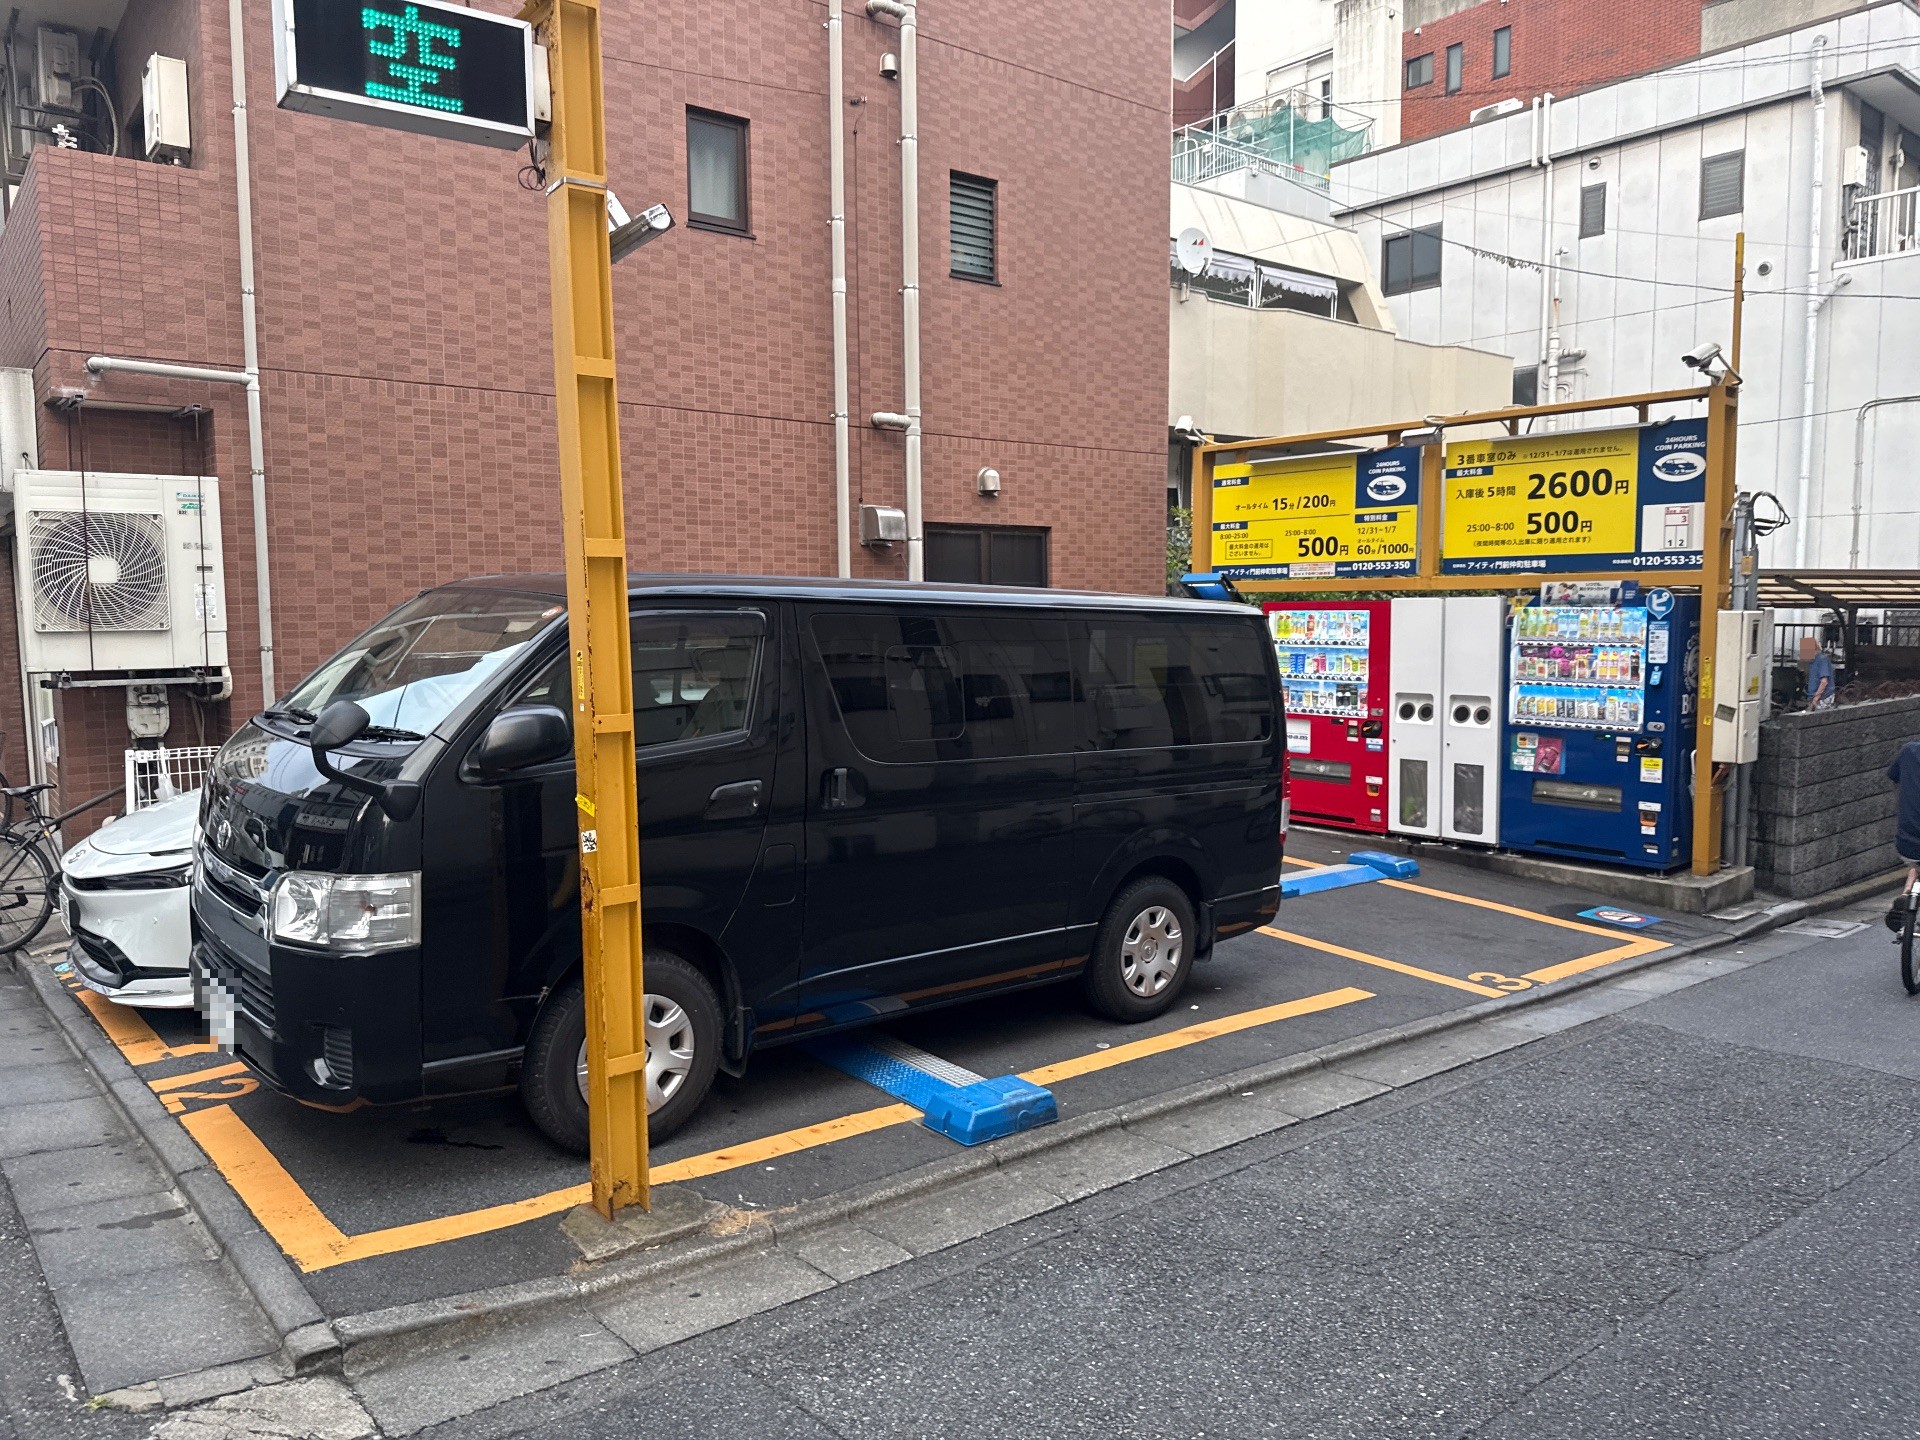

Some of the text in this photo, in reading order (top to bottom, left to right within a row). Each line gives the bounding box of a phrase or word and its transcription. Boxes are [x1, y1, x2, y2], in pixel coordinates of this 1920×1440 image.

[361, 5, 463, 112] 空
[1665, 435, 1698, 443] 24HOURS
[1673, 441, 1706, 450] PARKING
[1457, 451, 1517, 466] 3番車室のみ
[1456, 468, 1483, 477] 最大料金
[1527, 468, 1629, 500] 2600円
[1235, 502, 1268, 511] オールタイム
[1363, 513, 1388, 522] 特別料金
[1681, 515, 1687, 523] 3
[1220, 522, 1240, 530] 最大料金
[1527, 510, 1592, 535] 500円
[1298, 536, 1349, 558] 500円
[1667, 539, 1673, 547] 1
[1678, 539, 1685, 547] 2
[1352, 560, 1411, 571] 0120-553-350
[1467, 971, 1532, 991] 3
[160, 1077, 260, 1114] 2
